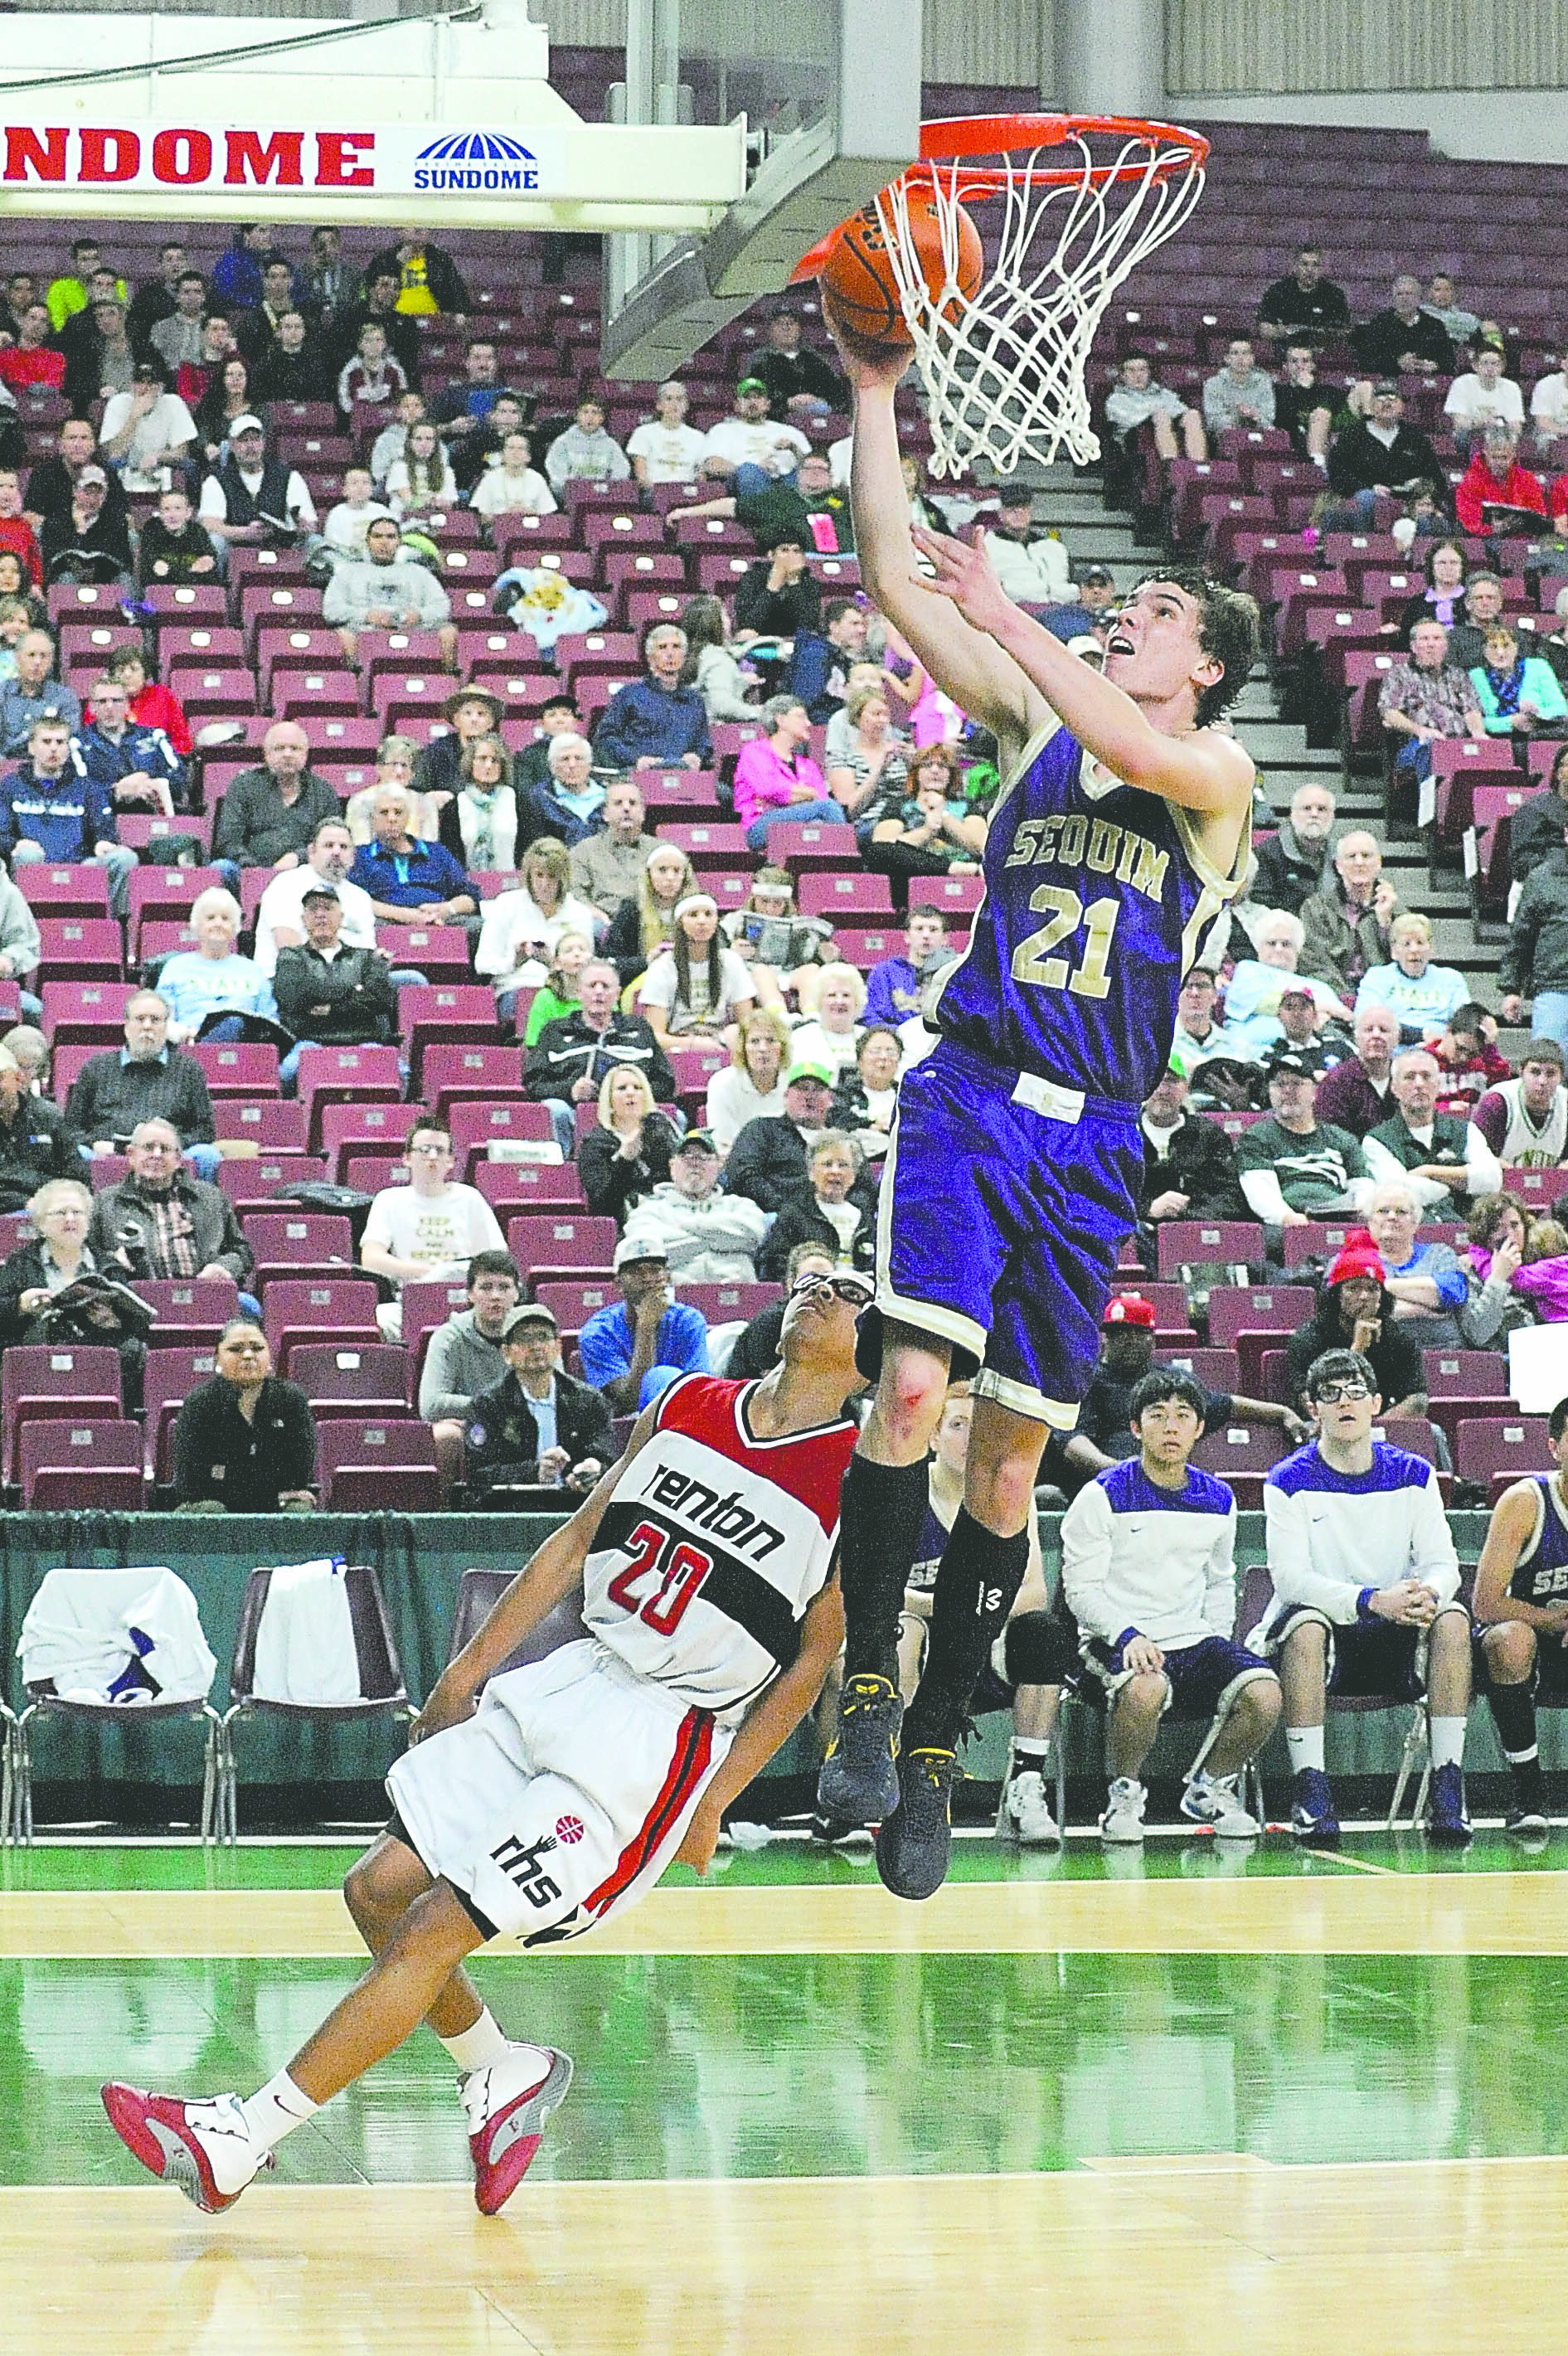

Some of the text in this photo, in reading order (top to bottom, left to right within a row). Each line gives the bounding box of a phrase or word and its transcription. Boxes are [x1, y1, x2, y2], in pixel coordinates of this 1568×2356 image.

[2, 127, 376, 186] NDOME
[414, 169, 538, 189] SUNDOME
[1004, 815, 1171, 903] SEQUIM
[1011, 884, 1121, 999] 21
[640, 1464, 786, 1562] renton
[607, 1521, 712, 1637] 20
[489, 1834, 562, 1908] rhs
